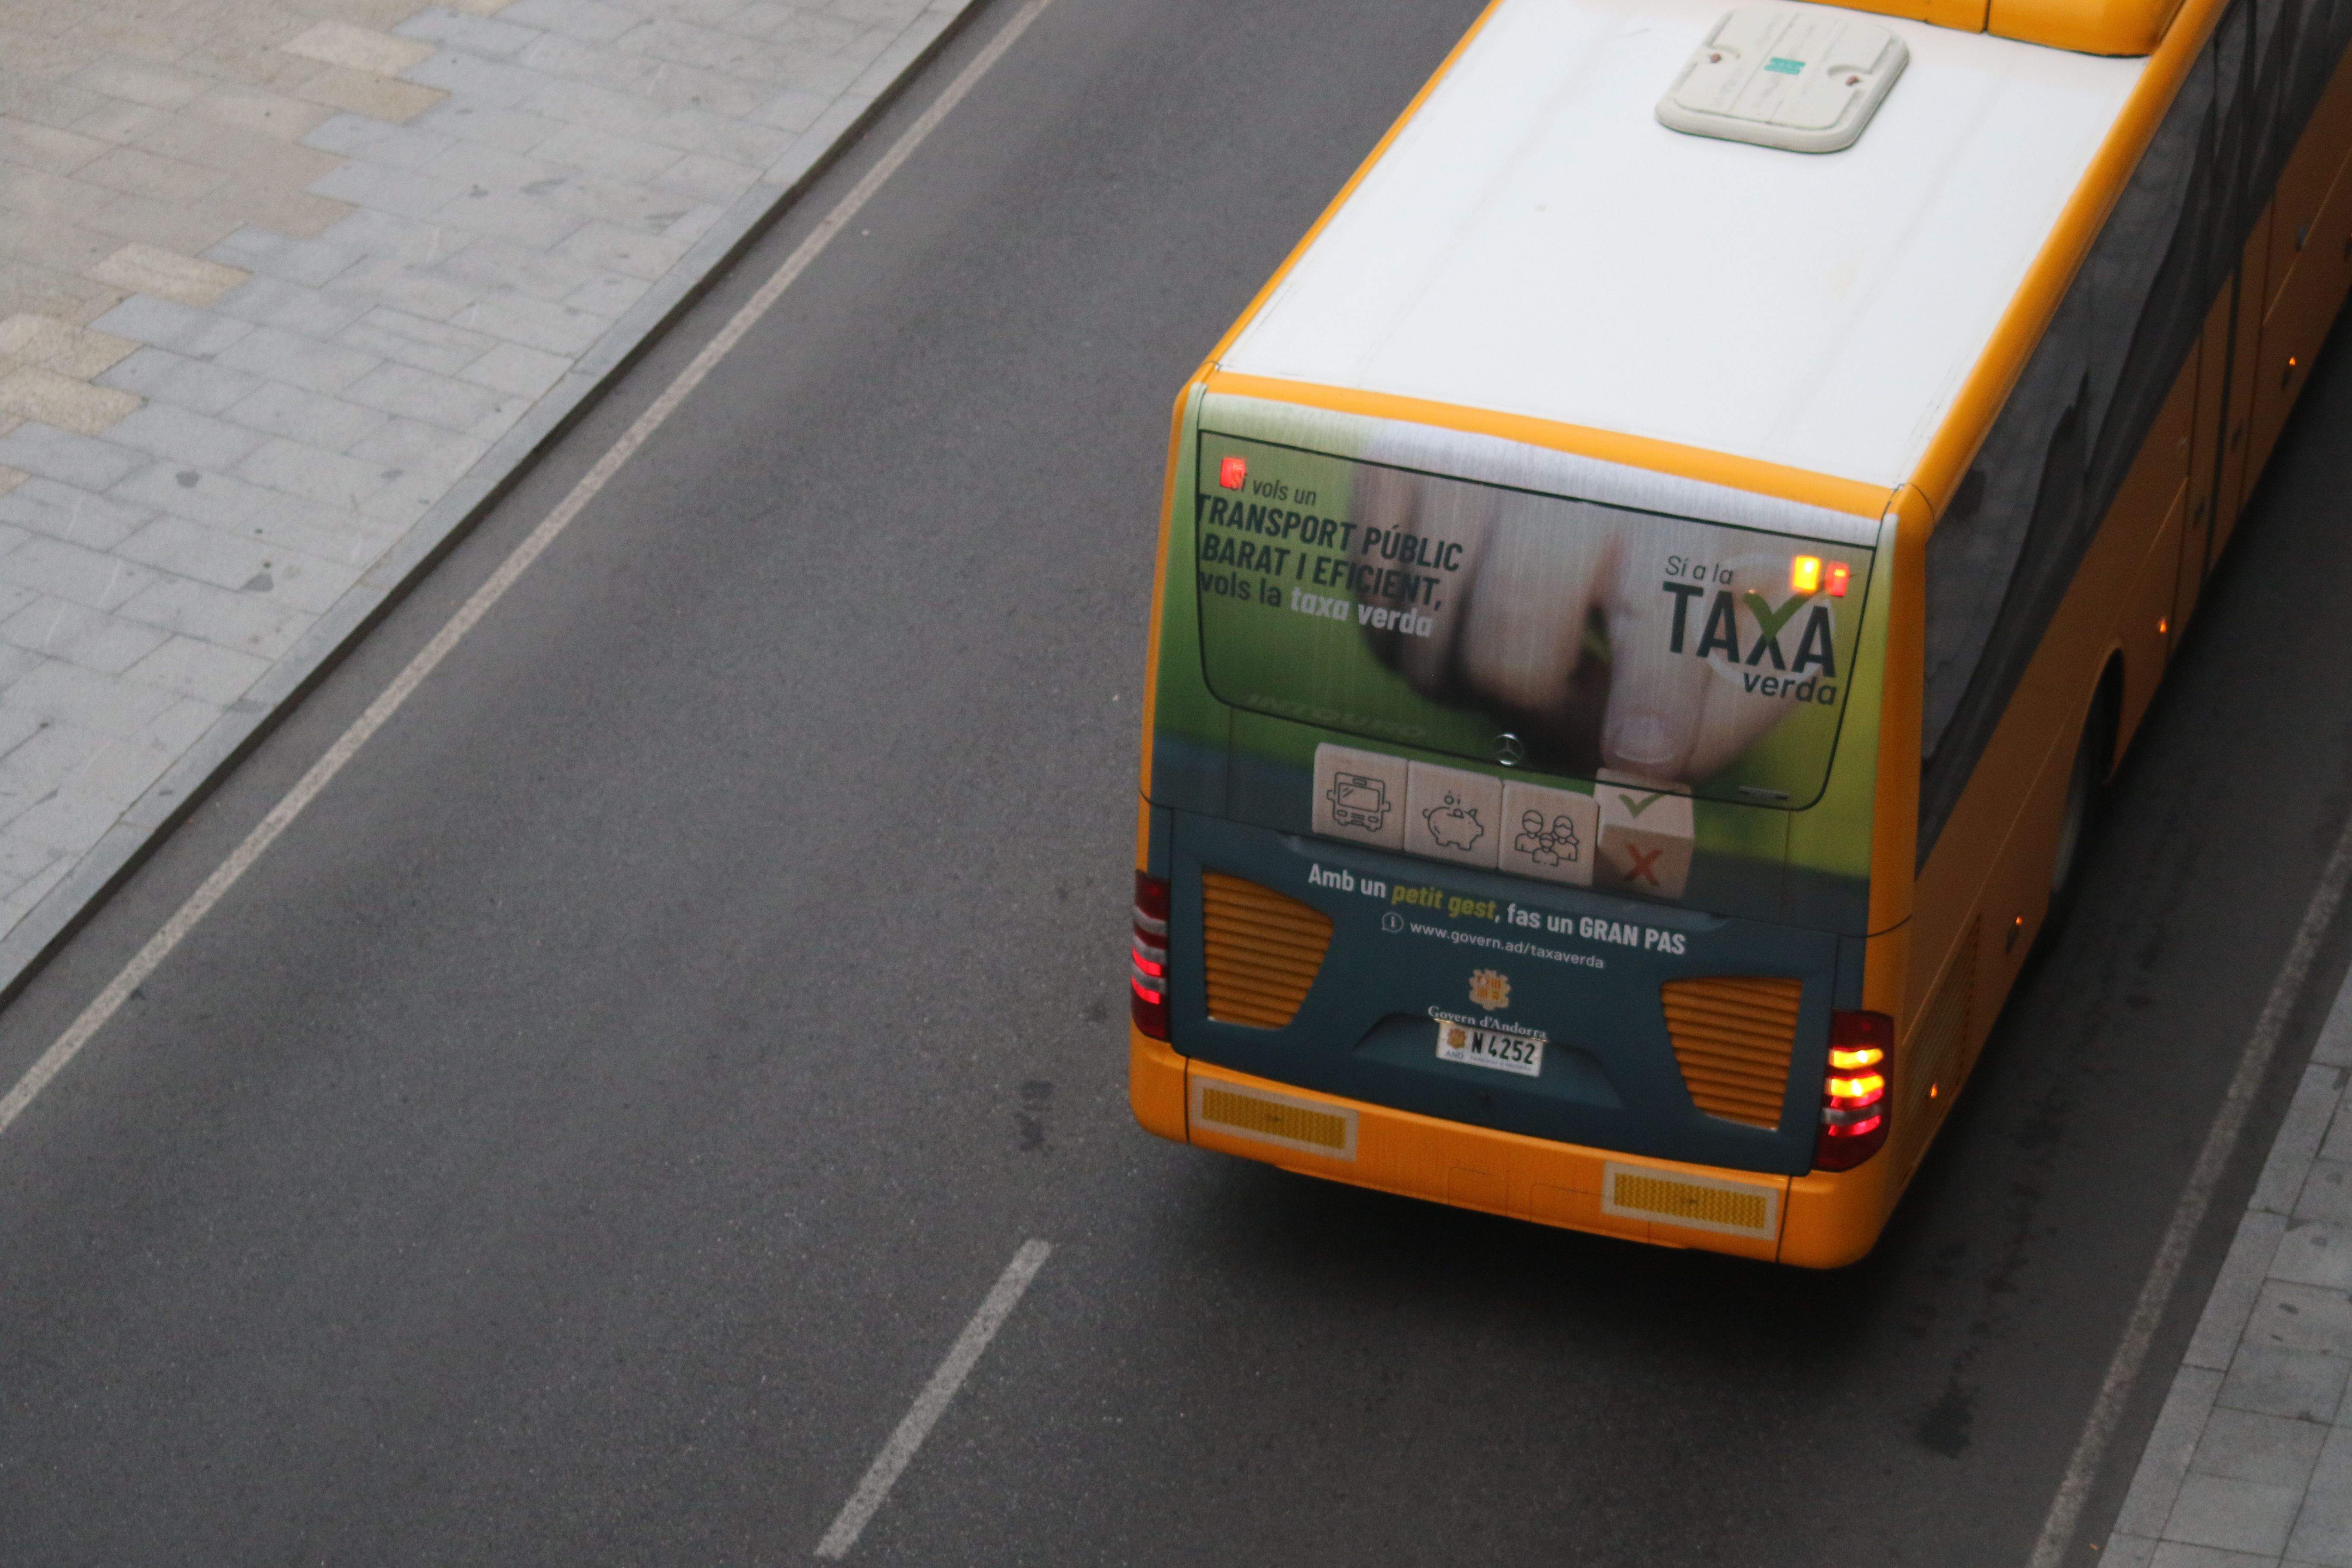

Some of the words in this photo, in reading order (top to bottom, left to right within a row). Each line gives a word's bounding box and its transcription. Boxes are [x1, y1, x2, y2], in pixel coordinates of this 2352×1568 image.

[1253, 479, 1288, 501] vols
[1294, 488, 1317, 506] un
[1197, 493, 1357, 551] TRANSPORT
[1361, 524, 1464, 572] PÚBLIC
[1202, 533, 1291, 576] BARAT
[1296, 552, 1306, 581] I
[1312, 556, 1441, 611] EFICIENT,
[1665, 555, 1688, 577] Sí
[1693, 565, 1706, 581] a
[1712, 563, 1733, 585] la
[1198, 572, 1251, 600] vols
[1259, 578, 1281, 607] la
[1290, 587, 1351, 622] taxa
[1357, 603, 1434, 637] verda
[1662, 581, 1835, 678] TAXA
[1743, 671, 1837, 706] verda
[1308, 863, 1354, 892] Amb
[1360, 879, 1387, 898] un
[1391, 885, 1444, 910] petit
[1448, 896, 1501, 923] gest,
[1507, 903, 1541, 928] fas
[1547, 914, 1573, 935] un
[1579, 916, 1638, 947] GRAN
[1644, 928, 1686, 955] PAS
[1410, 922, 1605, 969] www.govern.ad/taxaverda
[1427, 1006, 1476, 1026] Govern
[1479, 1016, 1547, 1039] d'Andorra
[1472, 1032, 1483, 1054] N
[1488, 1035, 1536, 1065] 4252
